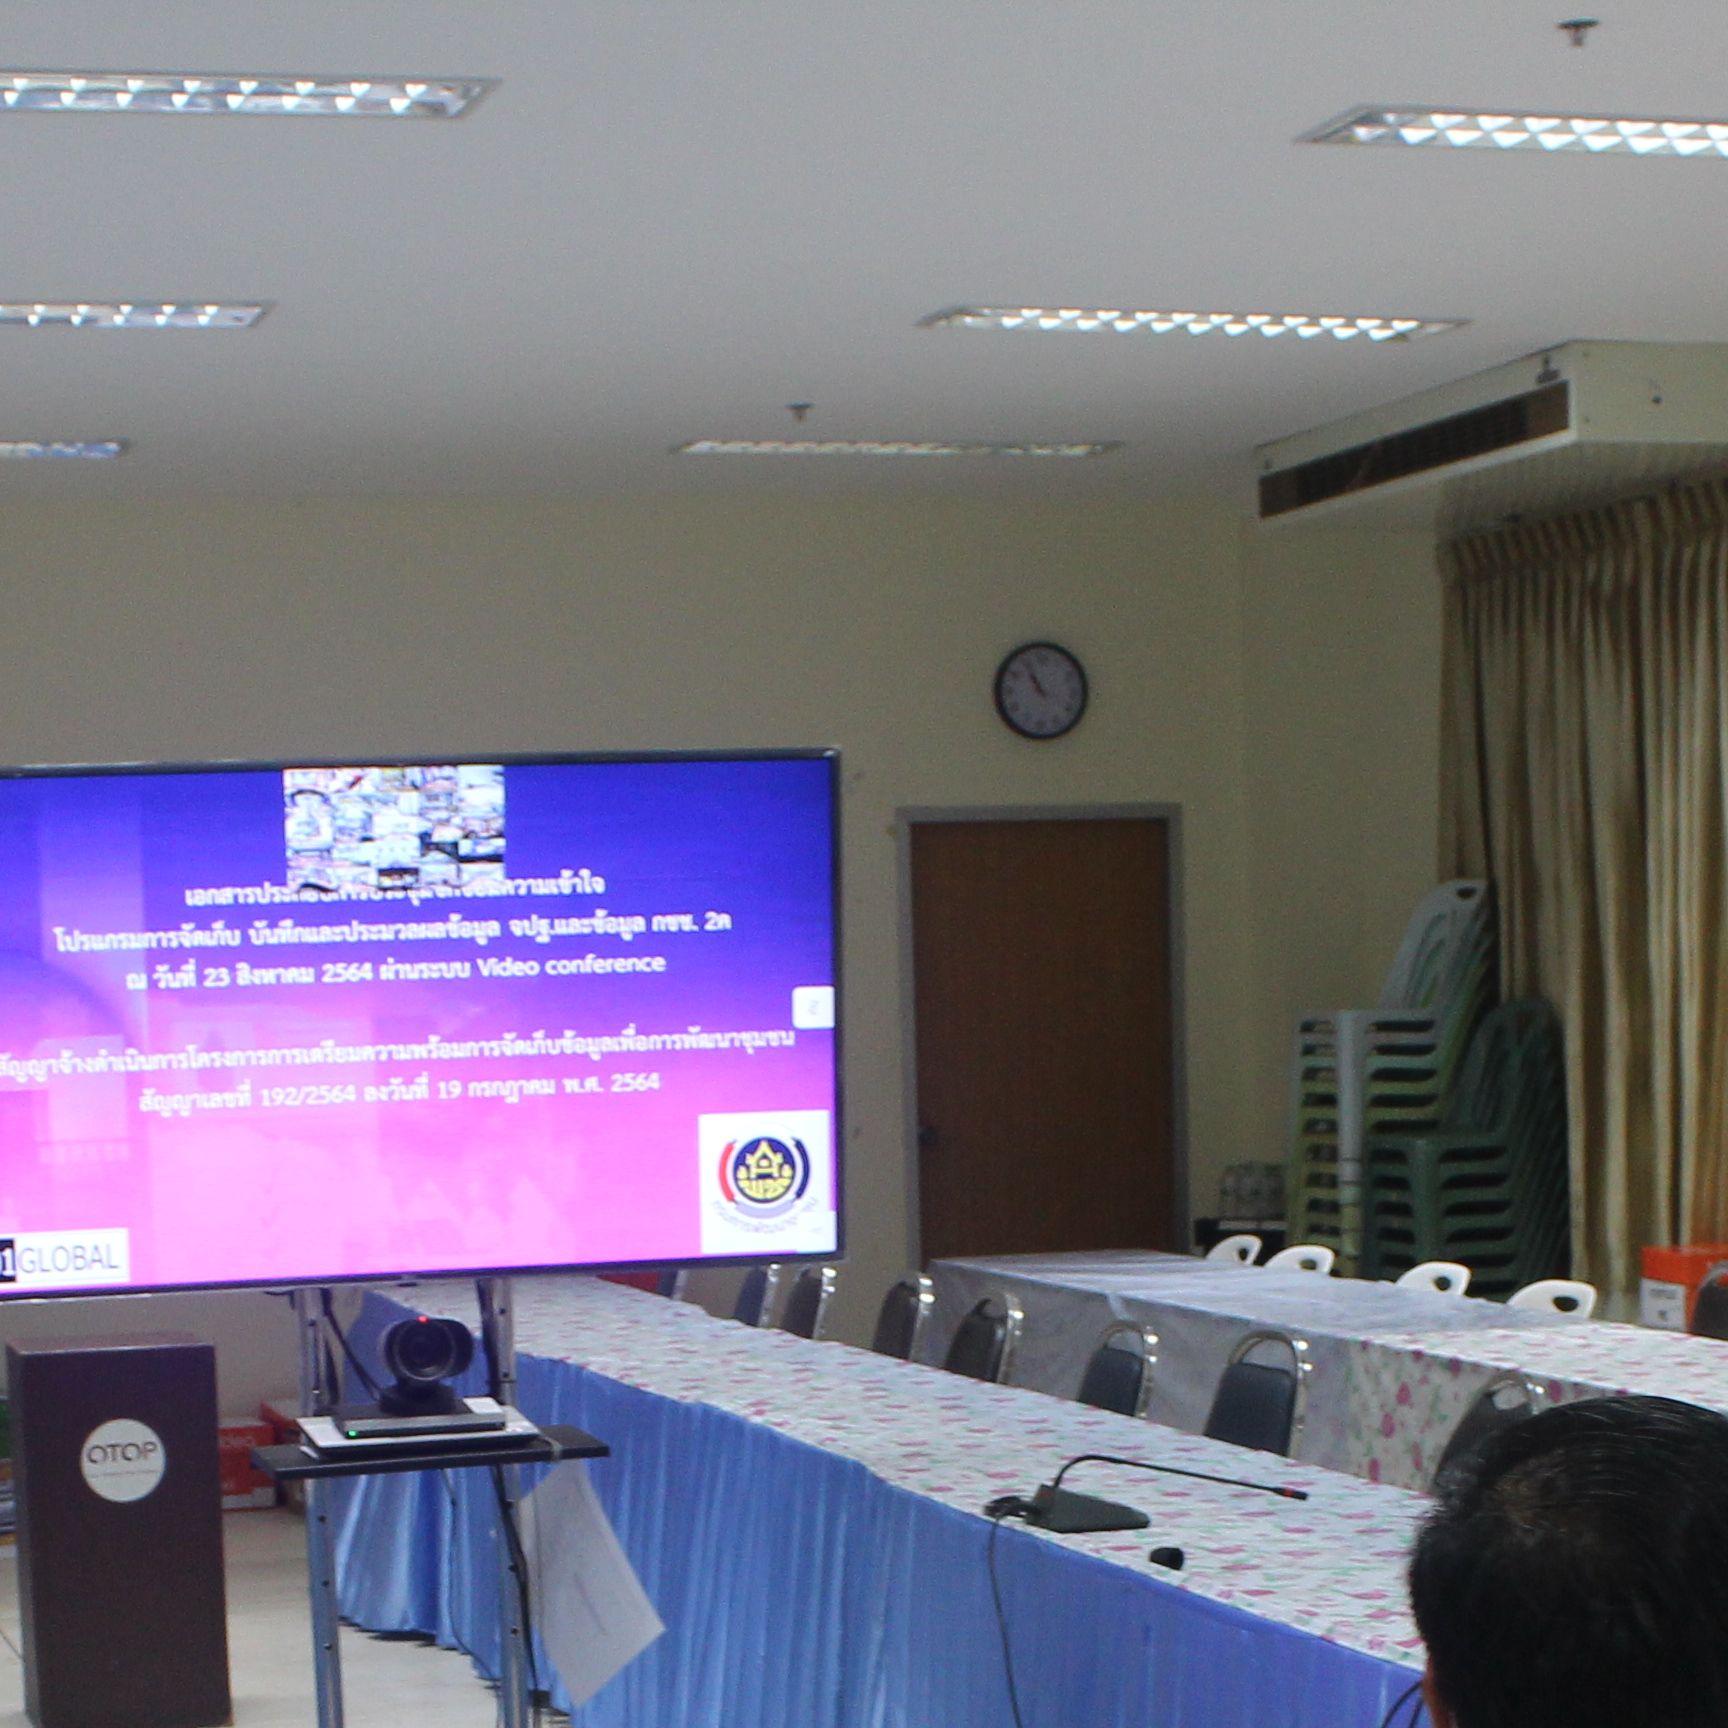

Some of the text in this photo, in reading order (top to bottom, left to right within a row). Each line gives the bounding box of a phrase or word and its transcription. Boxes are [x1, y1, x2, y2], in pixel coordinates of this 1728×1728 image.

[152, 958, 197, 989] วันที่
[202, 967, 231, 988] 23
[235, 962, 315, 986] สิงหาคม
[321, 962, 374, 983] 2564
[378, 957, 471, 981] ผ่านระบบ
[476, 957, 541, 978] Video
[544, 953, 667, 976] conference
[138, 1078, 252, 1117] สัญญาเลขที่
[259, 1084, 357, 1107] 192/2564
[363, 1071, 429, 1102] ลงวันที่
[437, 1080, 462, 1099] 19
[467, 1077, 556, 1103] กรกฎาคม
[610, 1072, 661, 1093] 2564
[17, 1243, 121, 1274] GLOBAL
[87, 1441, 158, 1465] OTOP
